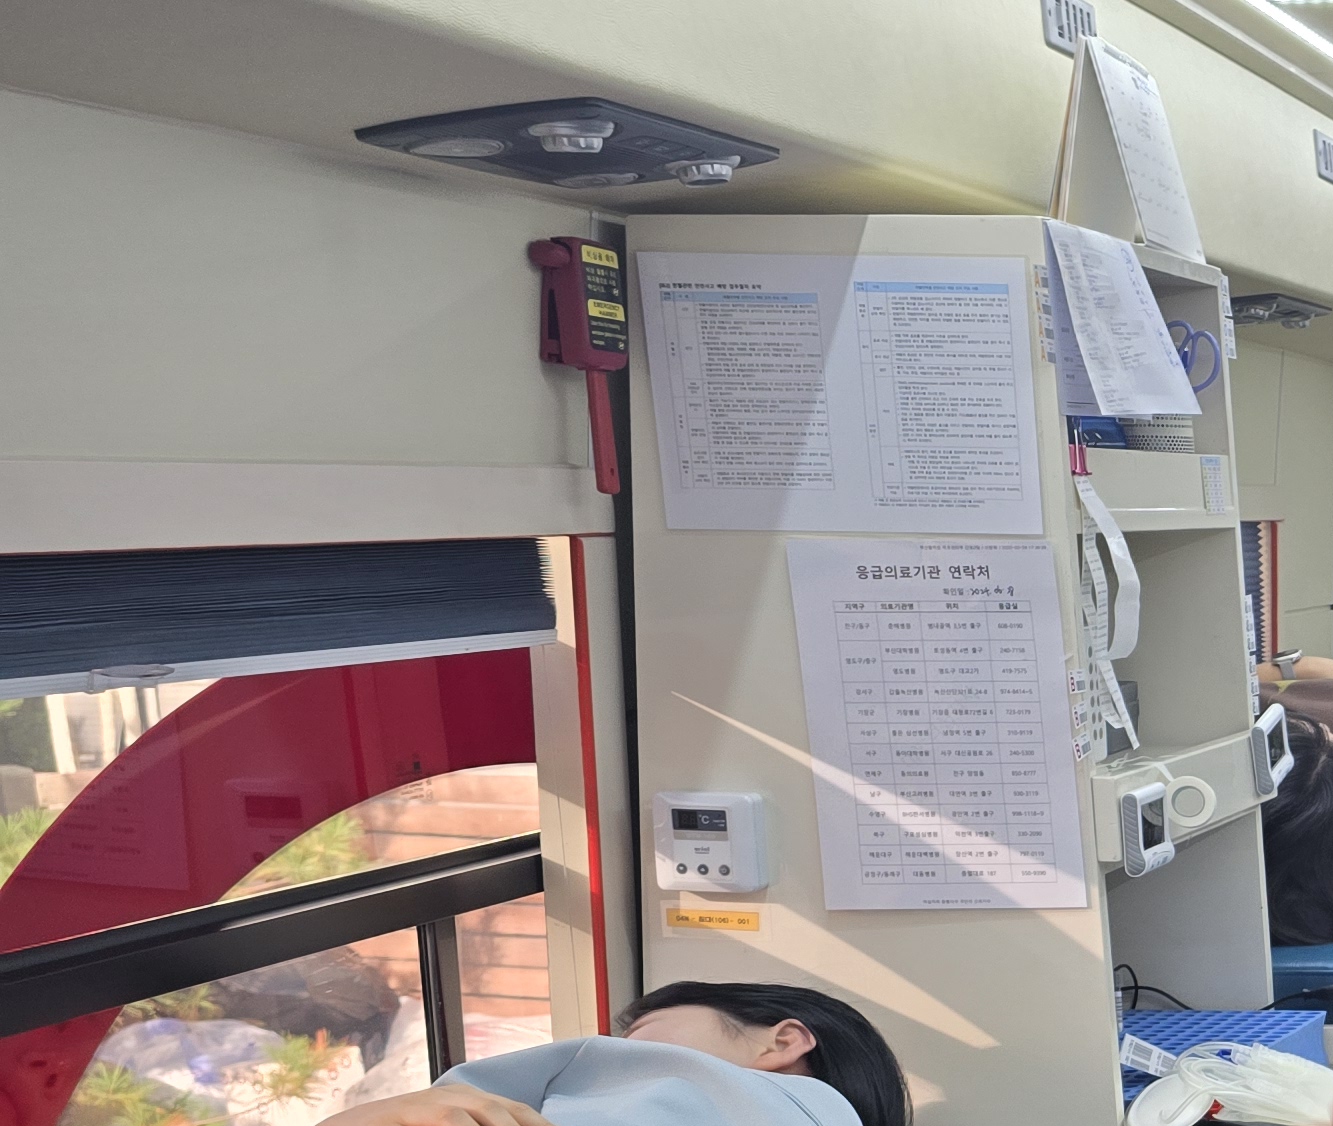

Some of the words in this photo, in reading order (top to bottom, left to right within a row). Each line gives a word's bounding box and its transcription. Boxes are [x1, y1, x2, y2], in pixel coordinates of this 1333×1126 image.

[856, 565, 941, 580] 응급의료기관
[948, 565, 991, 580] 연락처
[844, 603, 865, 611] 지역구
[880, 603, 914, 611] 의료기관명
[945, 602, 960, 610] 위치
[998, 602, 1019, 610] 응급실
